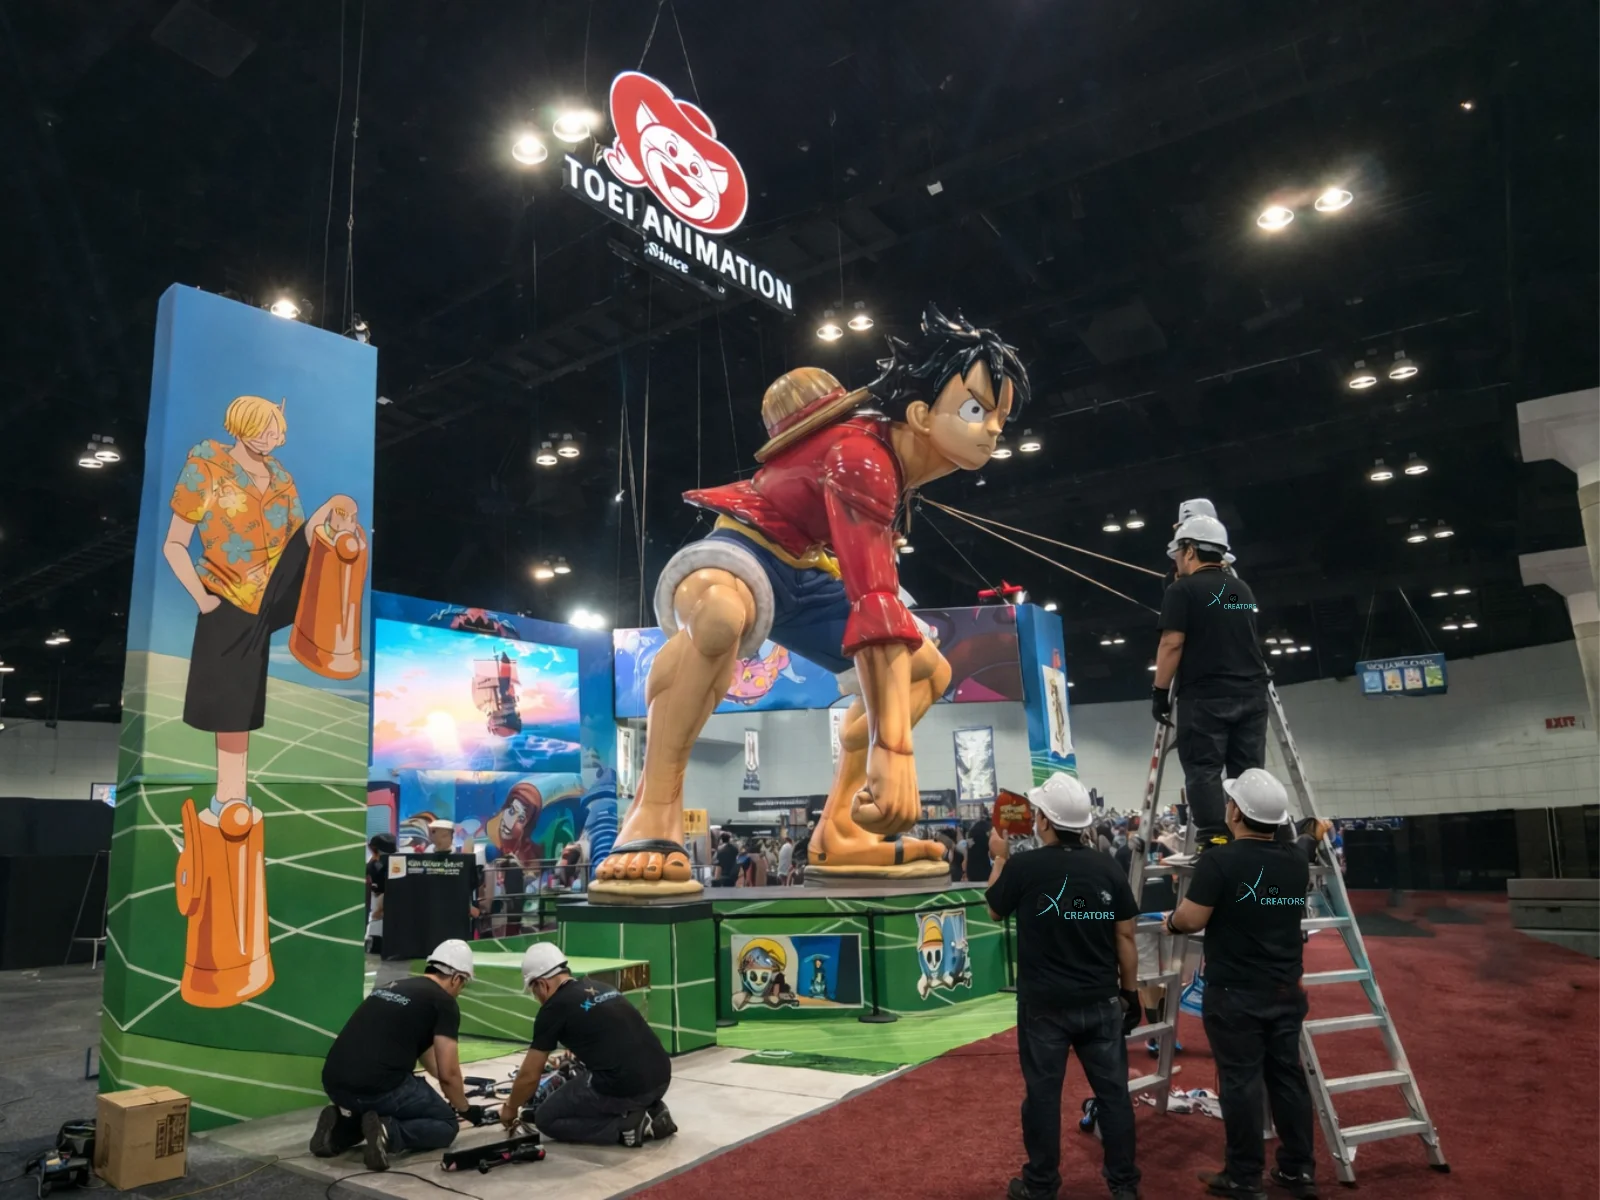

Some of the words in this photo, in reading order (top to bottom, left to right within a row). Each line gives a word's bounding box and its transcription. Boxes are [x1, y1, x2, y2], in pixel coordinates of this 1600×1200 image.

[564, 155, 634, 221] TOEI
[642, 205, 793, 310] ANIMATION
[647, 241, 689, 274] Since
[1545, 716, 1576, 729] EXIT
[1260, 897, 1305, 906] CREATORS
[1063, 911, 1115, 920] CREATORS
